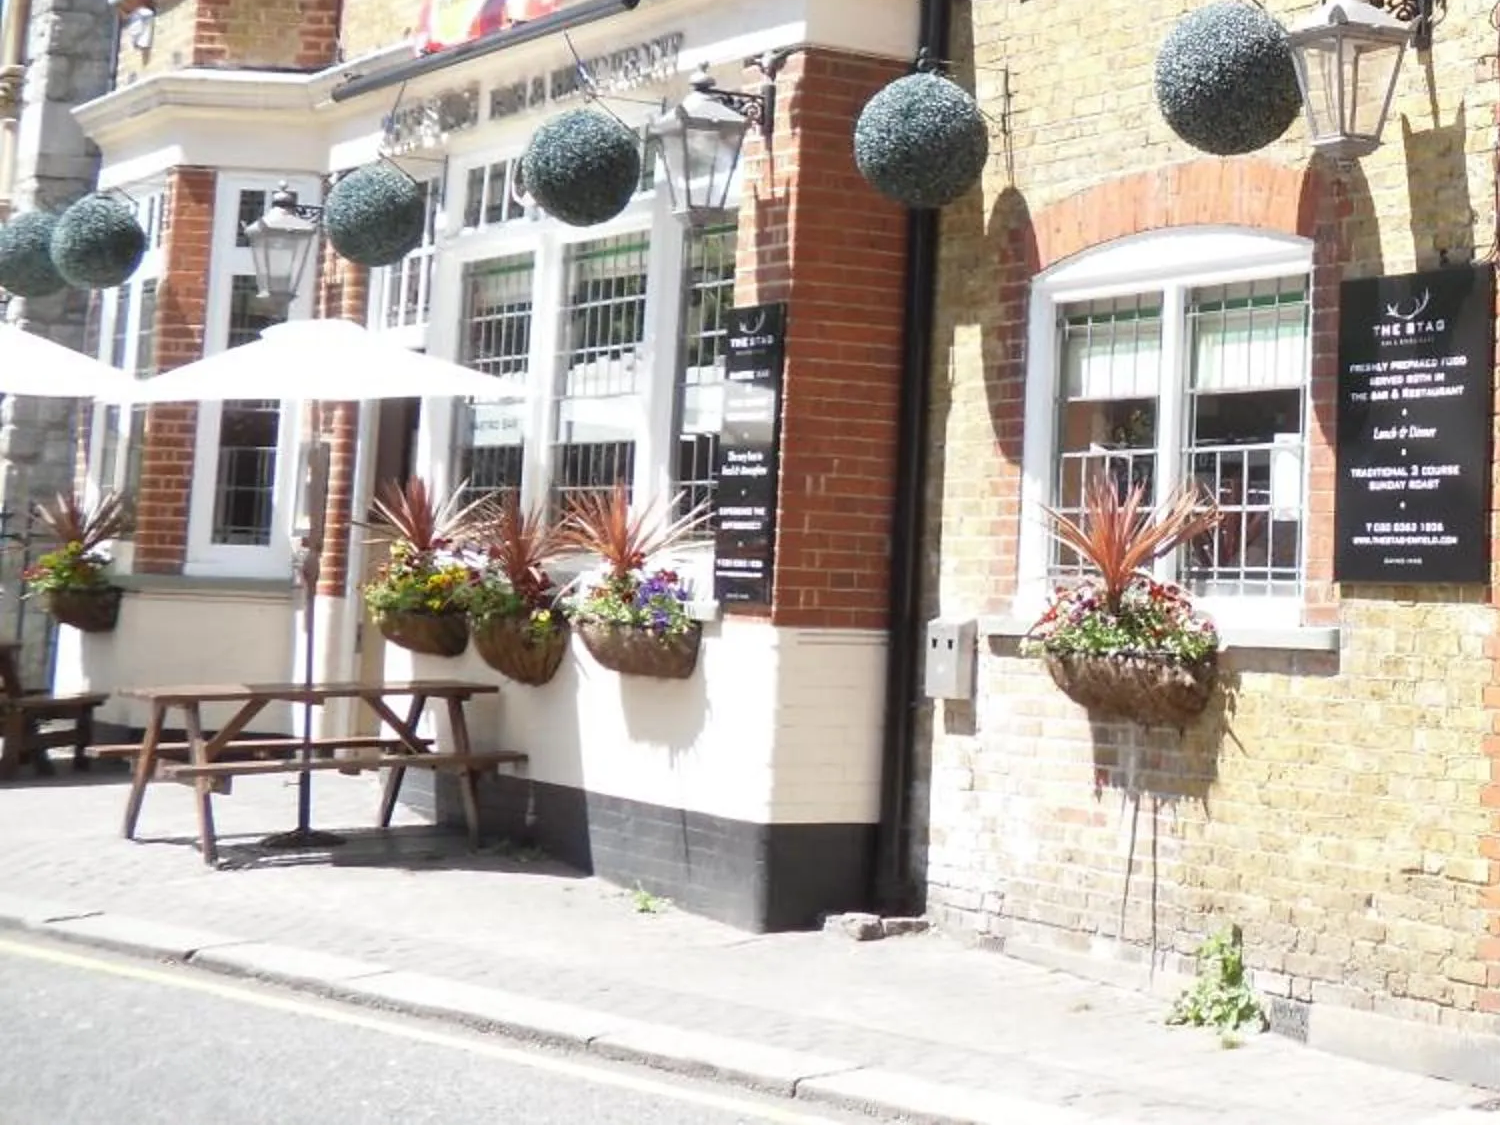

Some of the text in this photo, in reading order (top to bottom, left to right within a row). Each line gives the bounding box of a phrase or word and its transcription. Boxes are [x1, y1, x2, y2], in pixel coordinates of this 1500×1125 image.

[1371, 319, 1446, 337] THE STAG
[1349, 355, 1468, 373] FRESHLY PREPARED FOOD
[1369, 375, 1405, 386] SERVED
[1351, 392, 1368, 402] THE
[1370, 390, 1389, 401] BAR
[1390, 388, 1400, 400] &
[1373, 425, 1437, 440] Lunch & Dinner
[1350, 464, 1461, 478] TRADITIONAL 3 COURSE
[1368, 478, 1441, 491] SUNDAY ROAST
[1365, 522, 1373, 532] T
